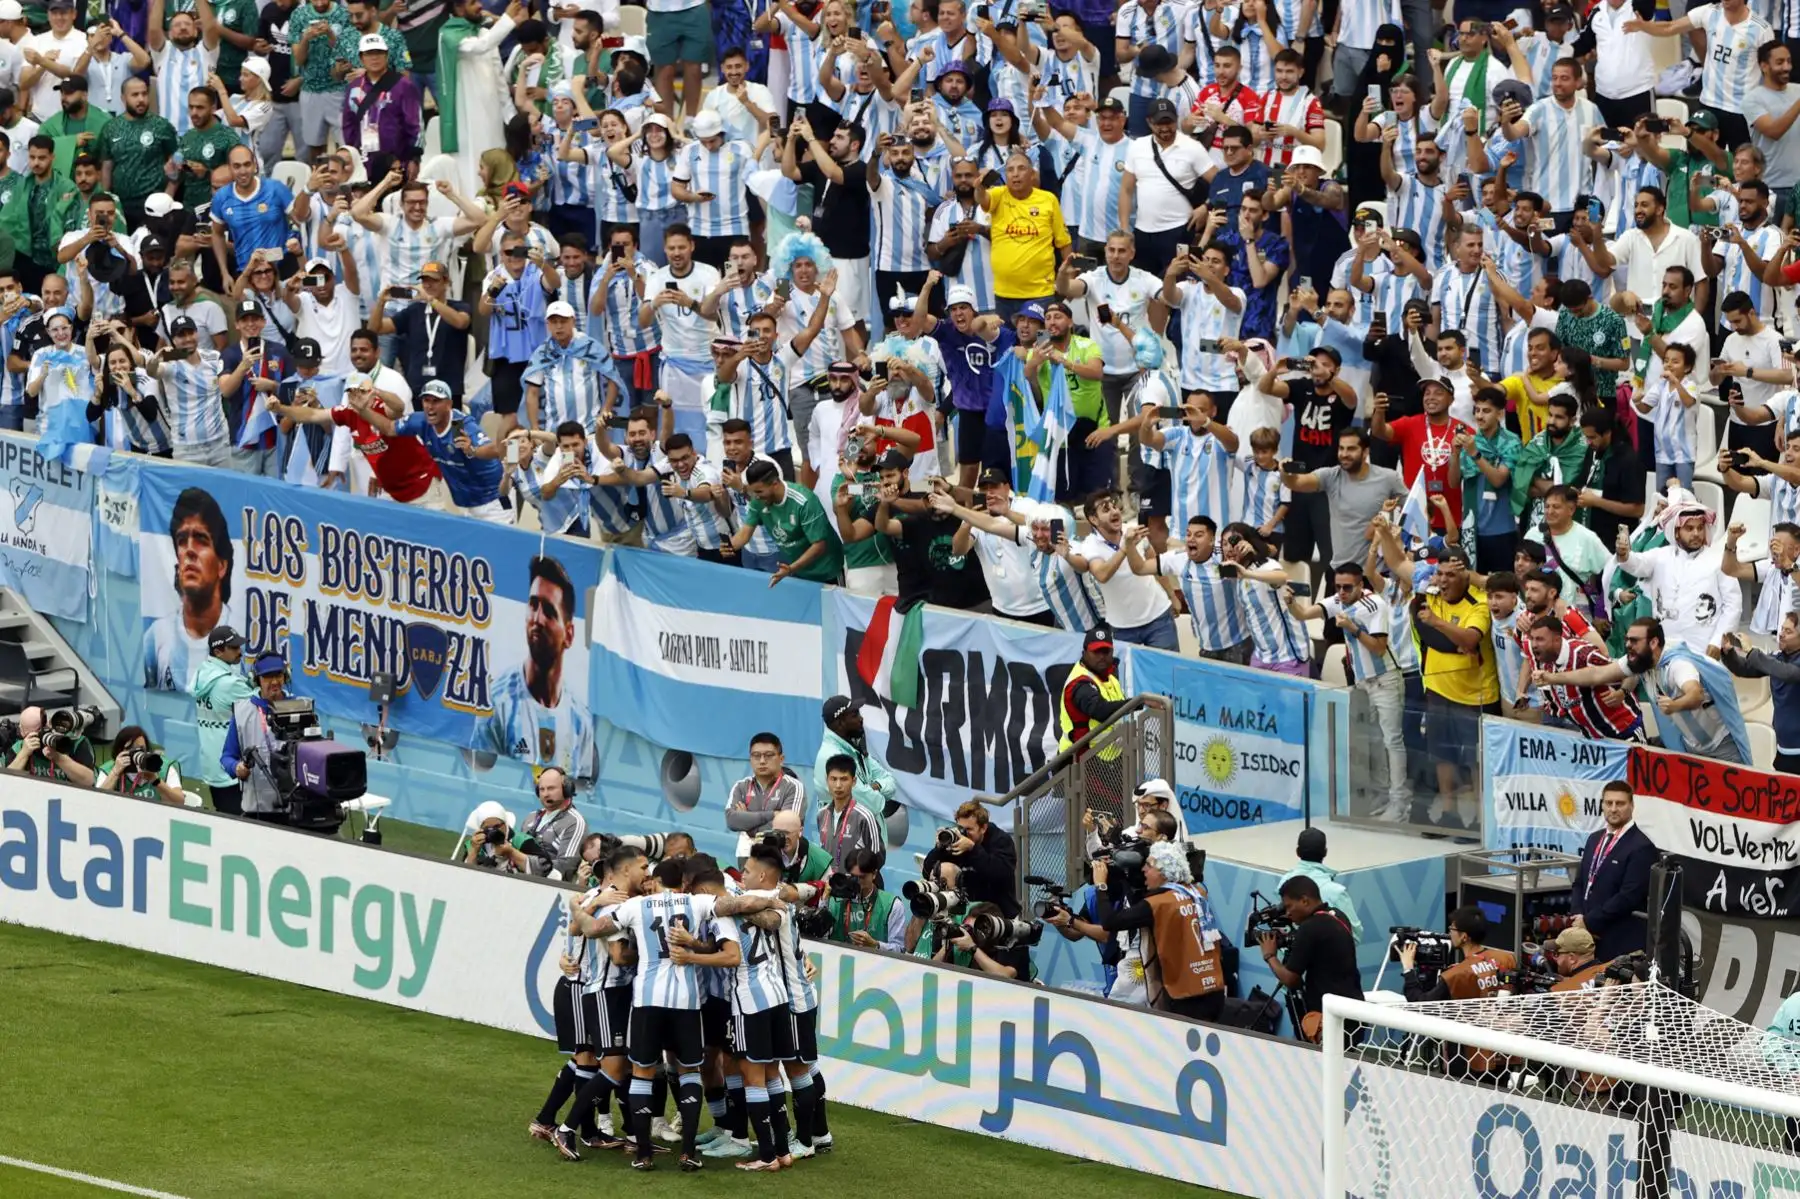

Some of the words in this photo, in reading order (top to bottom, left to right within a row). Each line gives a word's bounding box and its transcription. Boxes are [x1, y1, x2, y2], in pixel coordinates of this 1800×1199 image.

[1713, 44, 1732, 65] 22
[1301, 401, 1331, 431] WE
[244, 506, 306, 582] LOS
[320, 523, 493, 625] BOSTEROS
[245, 586, 293, 664] DE
[302, 597, 493, 712] MENDZA
[411, 647, 442, 666] CABJ
[694, 634, 721, 670] PAIVA
[729, 638, 756, 674] SANTA
[758, 640, 769, 675] FE
[1219, 704, 1278, 734] MARÍA
[1240, 751, 1301, 778] ISIDRO
[1519, 736, 1557, 762] EMA
[1571, 743, 1607, 767] JAVI
[1631, 750, 1670, 795] NO
[1180, 785, 1264, 823] CÓRDOBA
[1505, 791, 1548, 812] VILLA
[1584, 797, 1604, 817] MA
[0, 798, 447, 998] atarEnergy
[1705, 869, 1728, 912] A
[979, 1028, 1228, 1147] قطر
